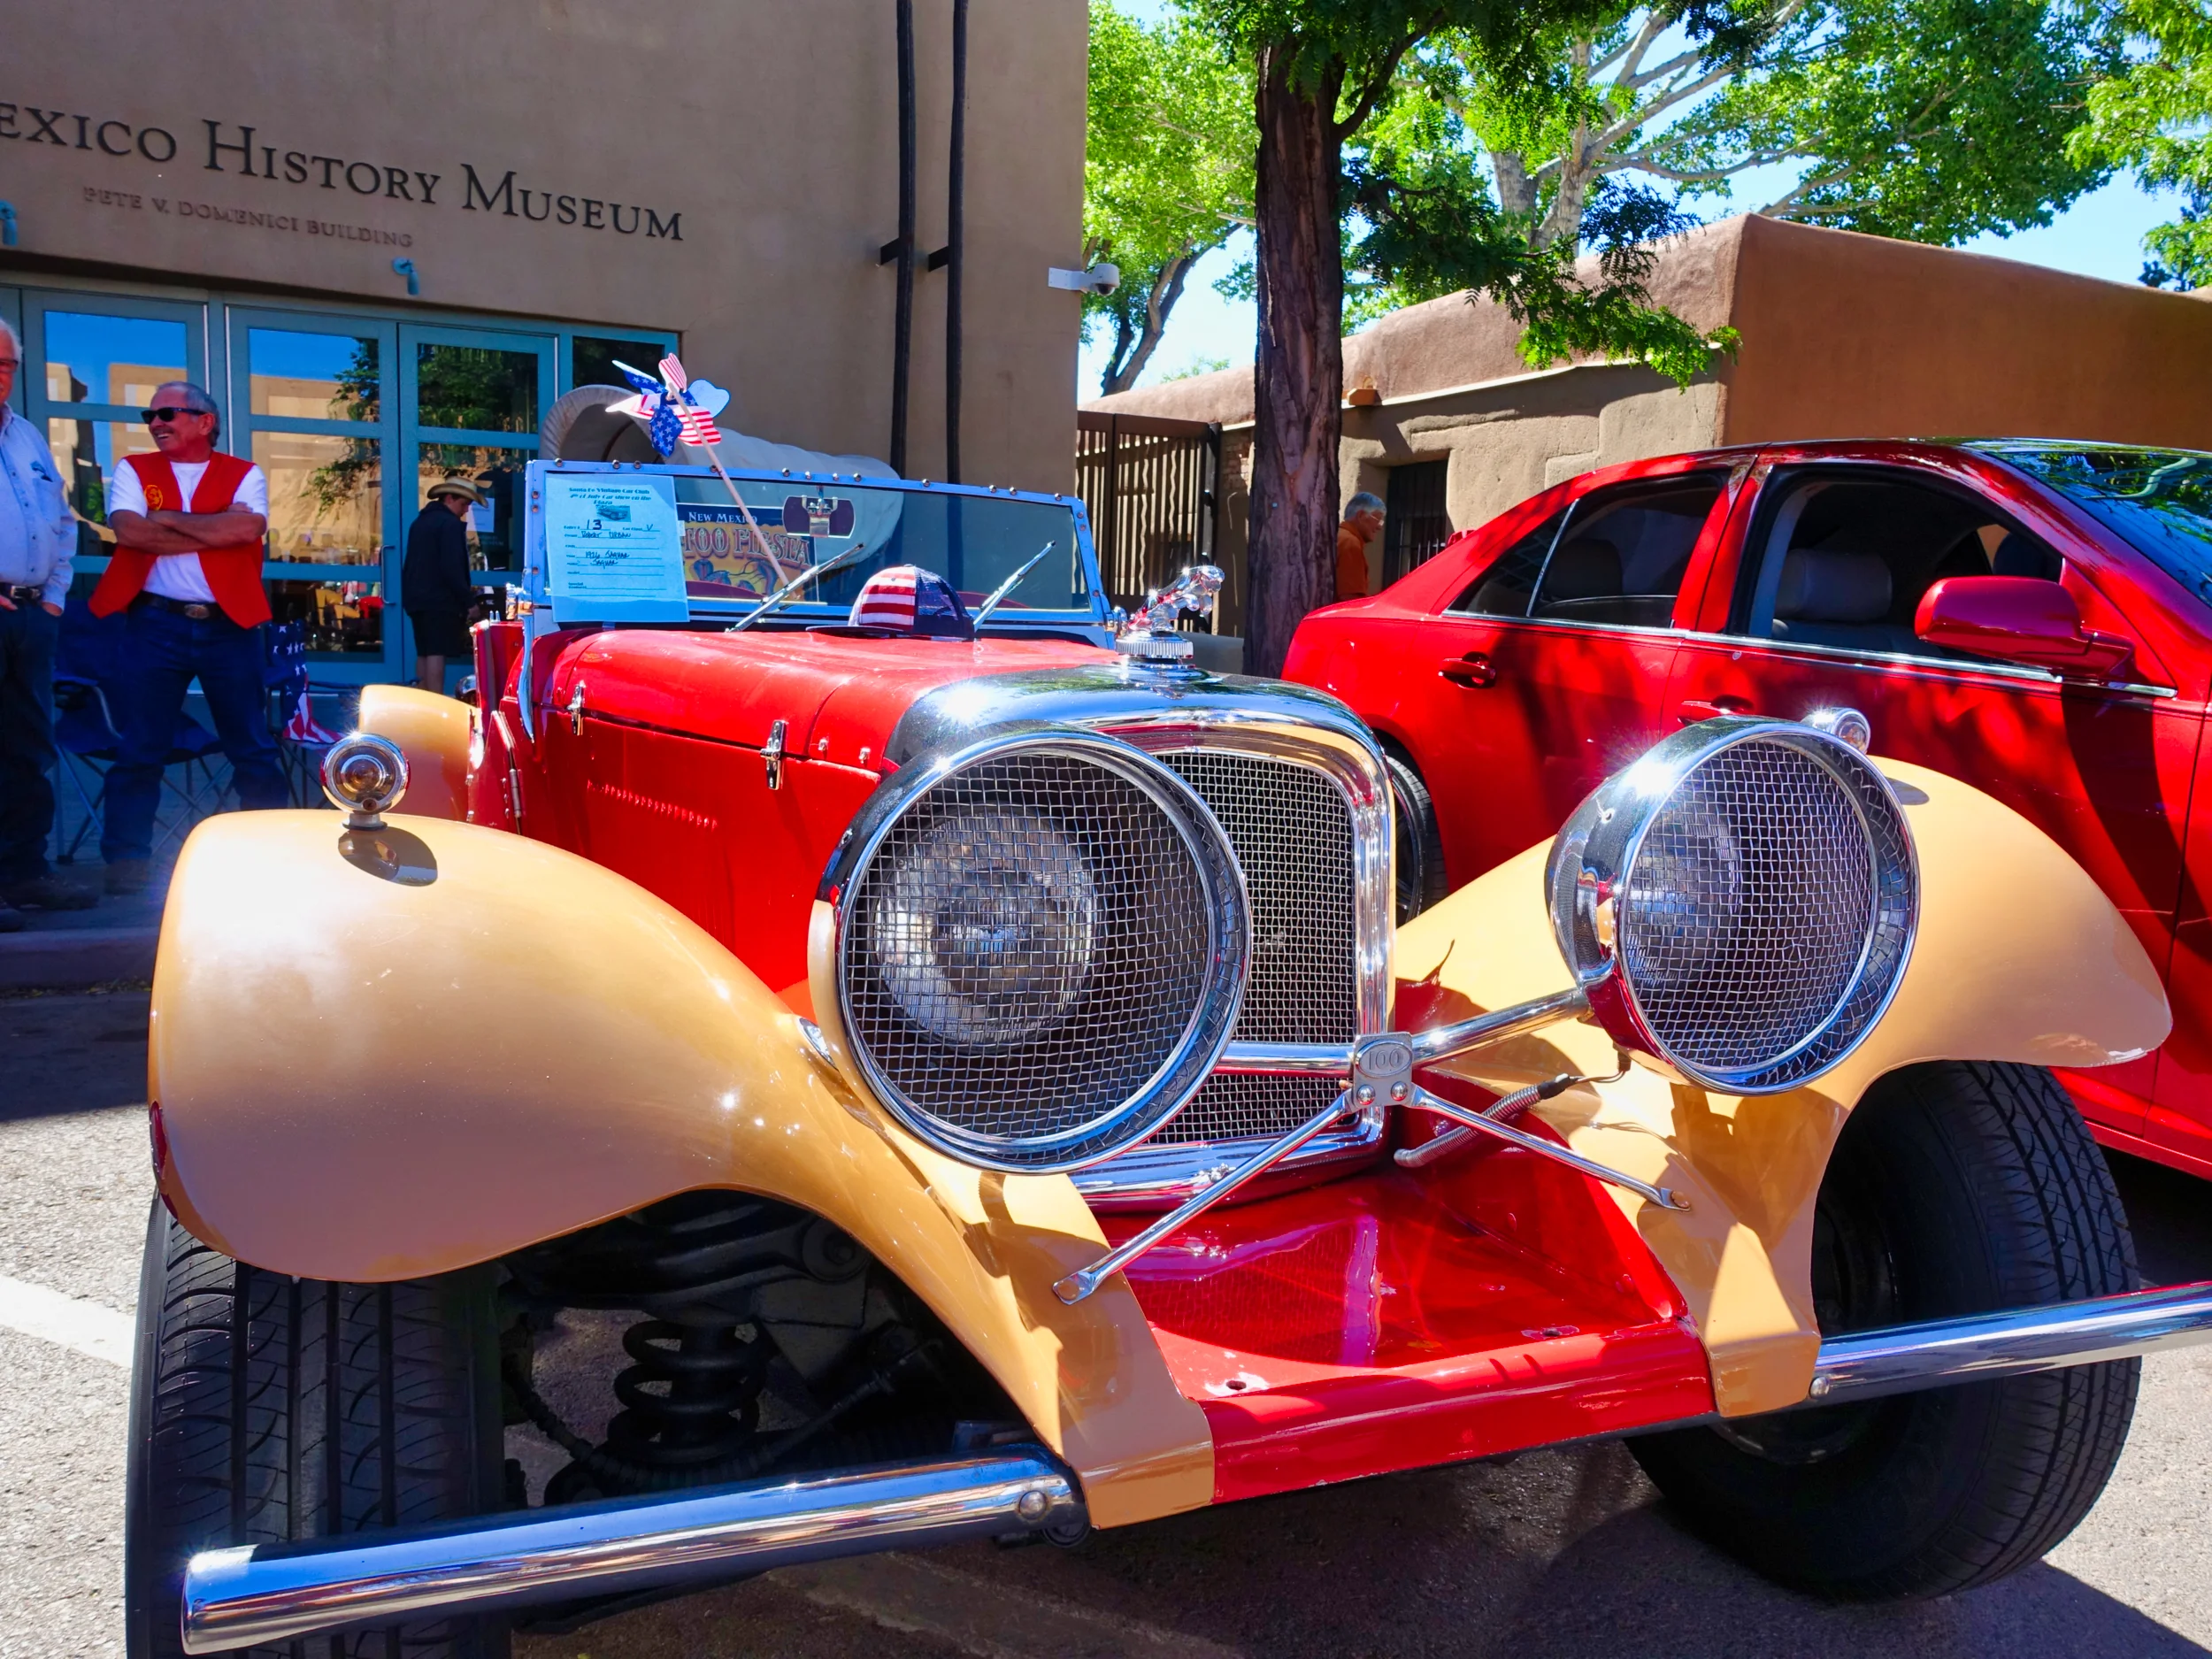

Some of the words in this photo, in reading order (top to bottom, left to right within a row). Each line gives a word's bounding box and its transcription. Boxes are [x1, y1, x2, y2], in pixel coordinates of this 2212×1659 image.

[0, 102, 177, 163] EXICO
[202, 119, 442, 204] HISTORY
[460, 163, 684, 242] MUSEUM
[83, 187, 142, 210] PETE
[151, 197, 170, 215] V.
[178, 200, 299, 232] DOMENICI
[307, 219, 413, 248] BUILDING
[587, 518, 602, 531] 13
[688, 511, 712, 523] NEW
[716, 513, 757, 525] MEXIO
[1368, 1048, 1403, 1071] 100
